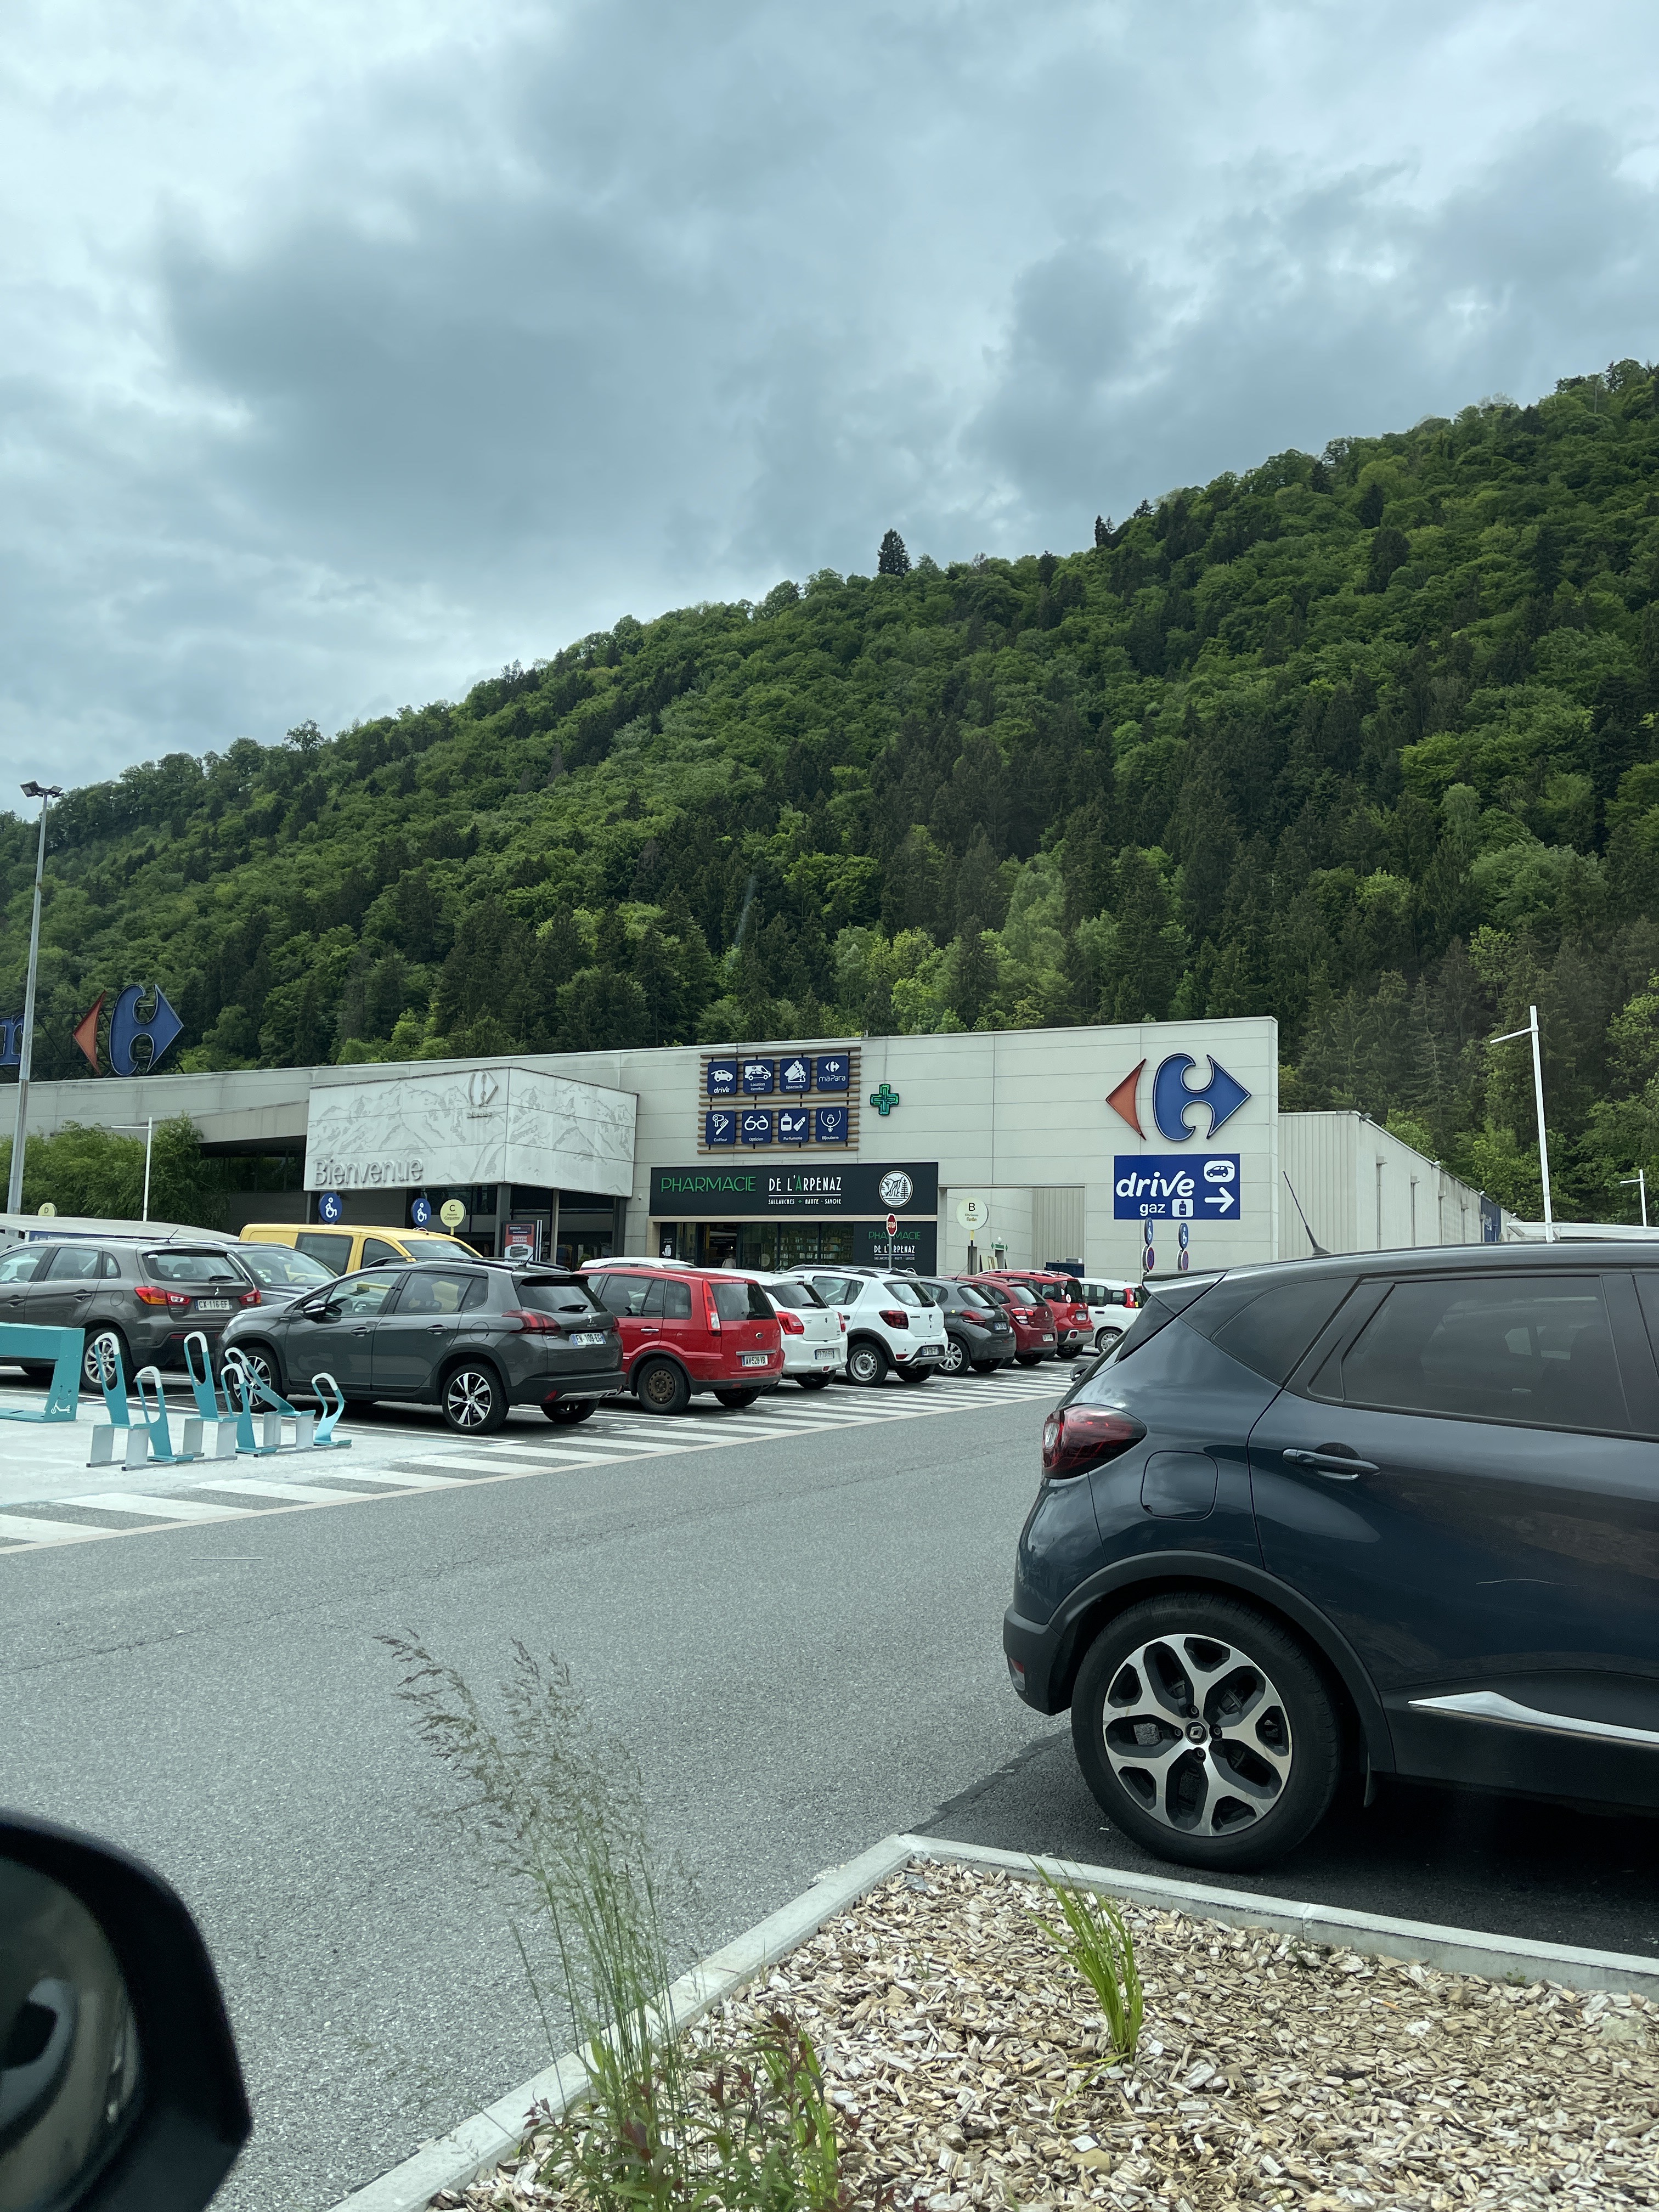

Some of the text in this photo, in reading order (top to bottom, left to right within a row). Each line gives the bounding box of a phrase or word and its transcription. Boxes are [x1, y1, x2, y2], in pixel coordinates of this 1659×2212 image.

[313, 1159, 423, 1185] Bienvenue
[661, 1175, 842, 1193] PHARMACIE DE L'ARPENAZ
[1116, 1170, 1195, 1197] drive
[968, 1203, 975, 1211] B
[1139, 1204, 1166, 1216] gaz
[868, 1231, 921, 1240] PHAMACIE
[874, 1243, 915, 1254] DE L'RPENAZ
[199, 1300, 228, 1308] CX-116-EF
